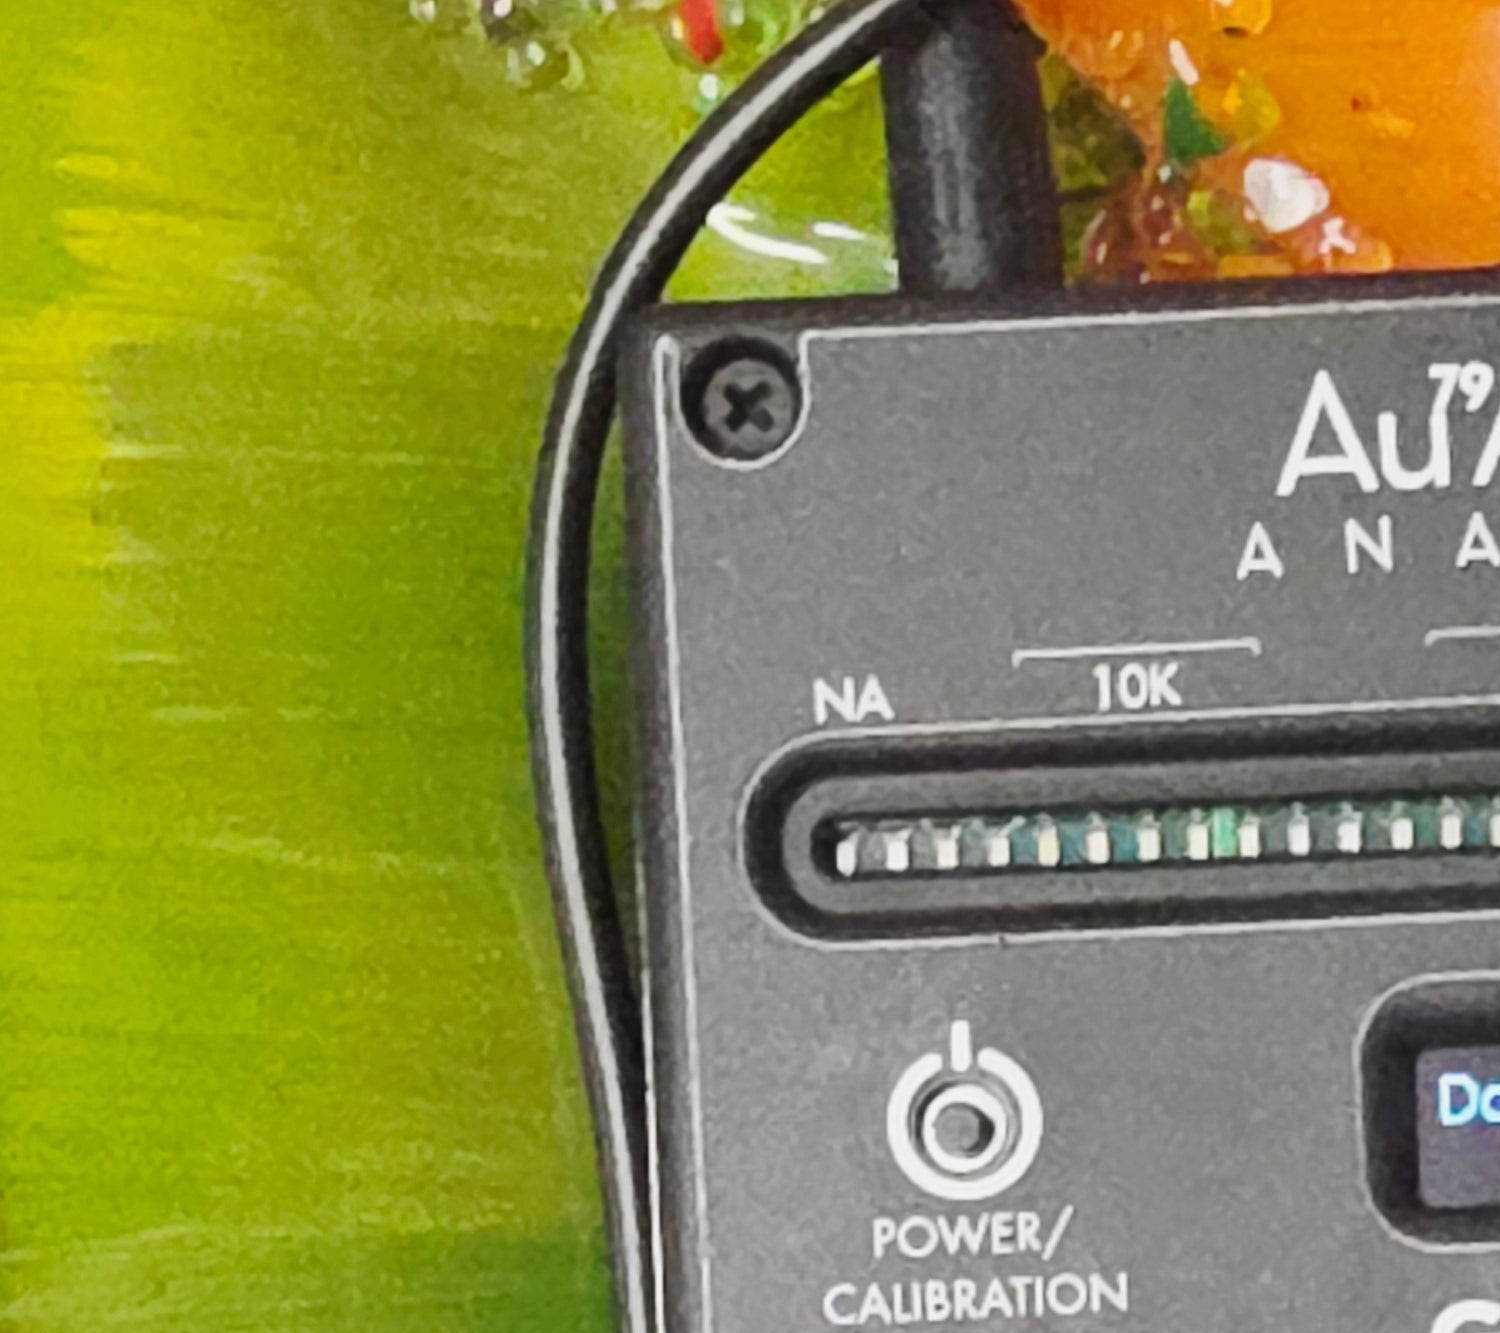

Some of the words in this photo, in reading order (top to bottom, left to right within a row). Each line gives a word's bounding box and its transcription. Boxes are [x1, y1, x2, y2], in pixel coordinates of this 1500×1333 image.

[814, 674, 893, 724] NA
[1093, 663, 1181, 711] 10K
[873, 1204, 1075, 1261] POWER/
[822, 1271, 1129, 1326] CALIBRATION
